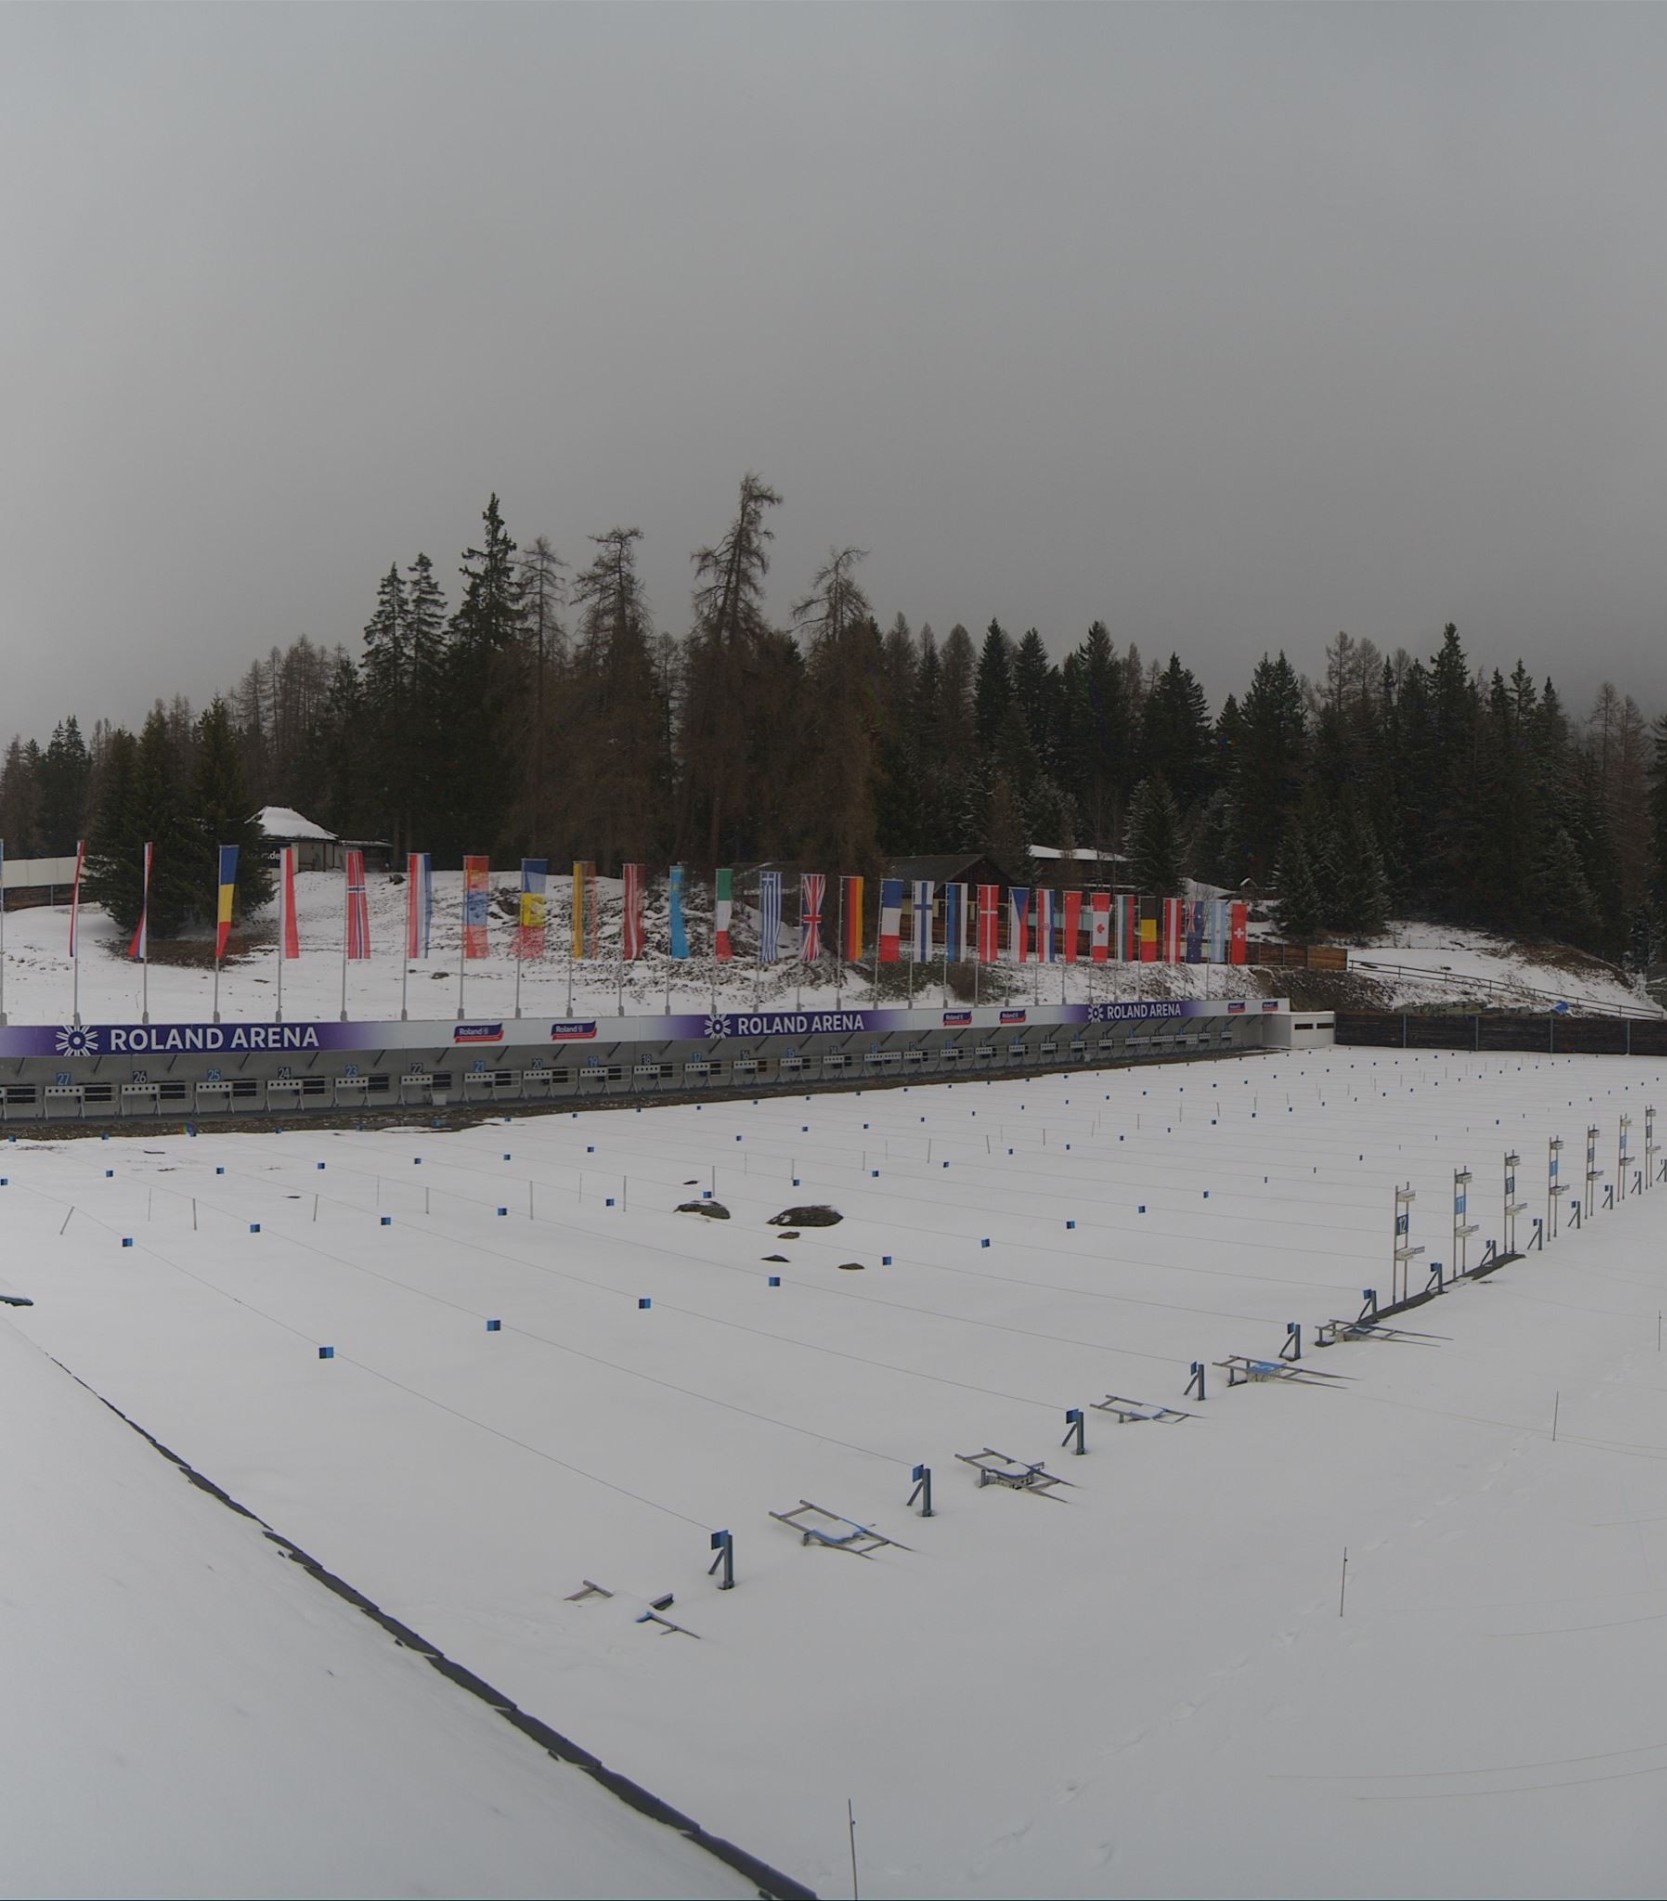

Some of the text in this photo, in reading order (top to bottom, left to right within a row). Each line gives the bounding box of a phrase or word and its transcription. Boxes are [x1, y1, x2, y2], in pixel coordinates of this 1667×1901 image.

[1107, 1003, 1181, 1019] ROLAND ARENA
[556, 1025, 578, 1033] Roland
[738, 1014, 865, 1035] ROLAND ARENA
[459, 1027, 483, 1036] Roland
[111, 1027, 319, 1051] ROLAND ARENA
[412, 1063, 422, 1074] 22
[533, 1060, 543, 1070] 20
[134, 1071, 147, 1083] 26
[208, 1069, 220, 1081] 25
[279, 1068, 290, 1079] 24
[347, 1066, 358, 1077] 23
[58, 1073, 70, 1085] 27
[1399, 1216, 1407, 1233] 12
